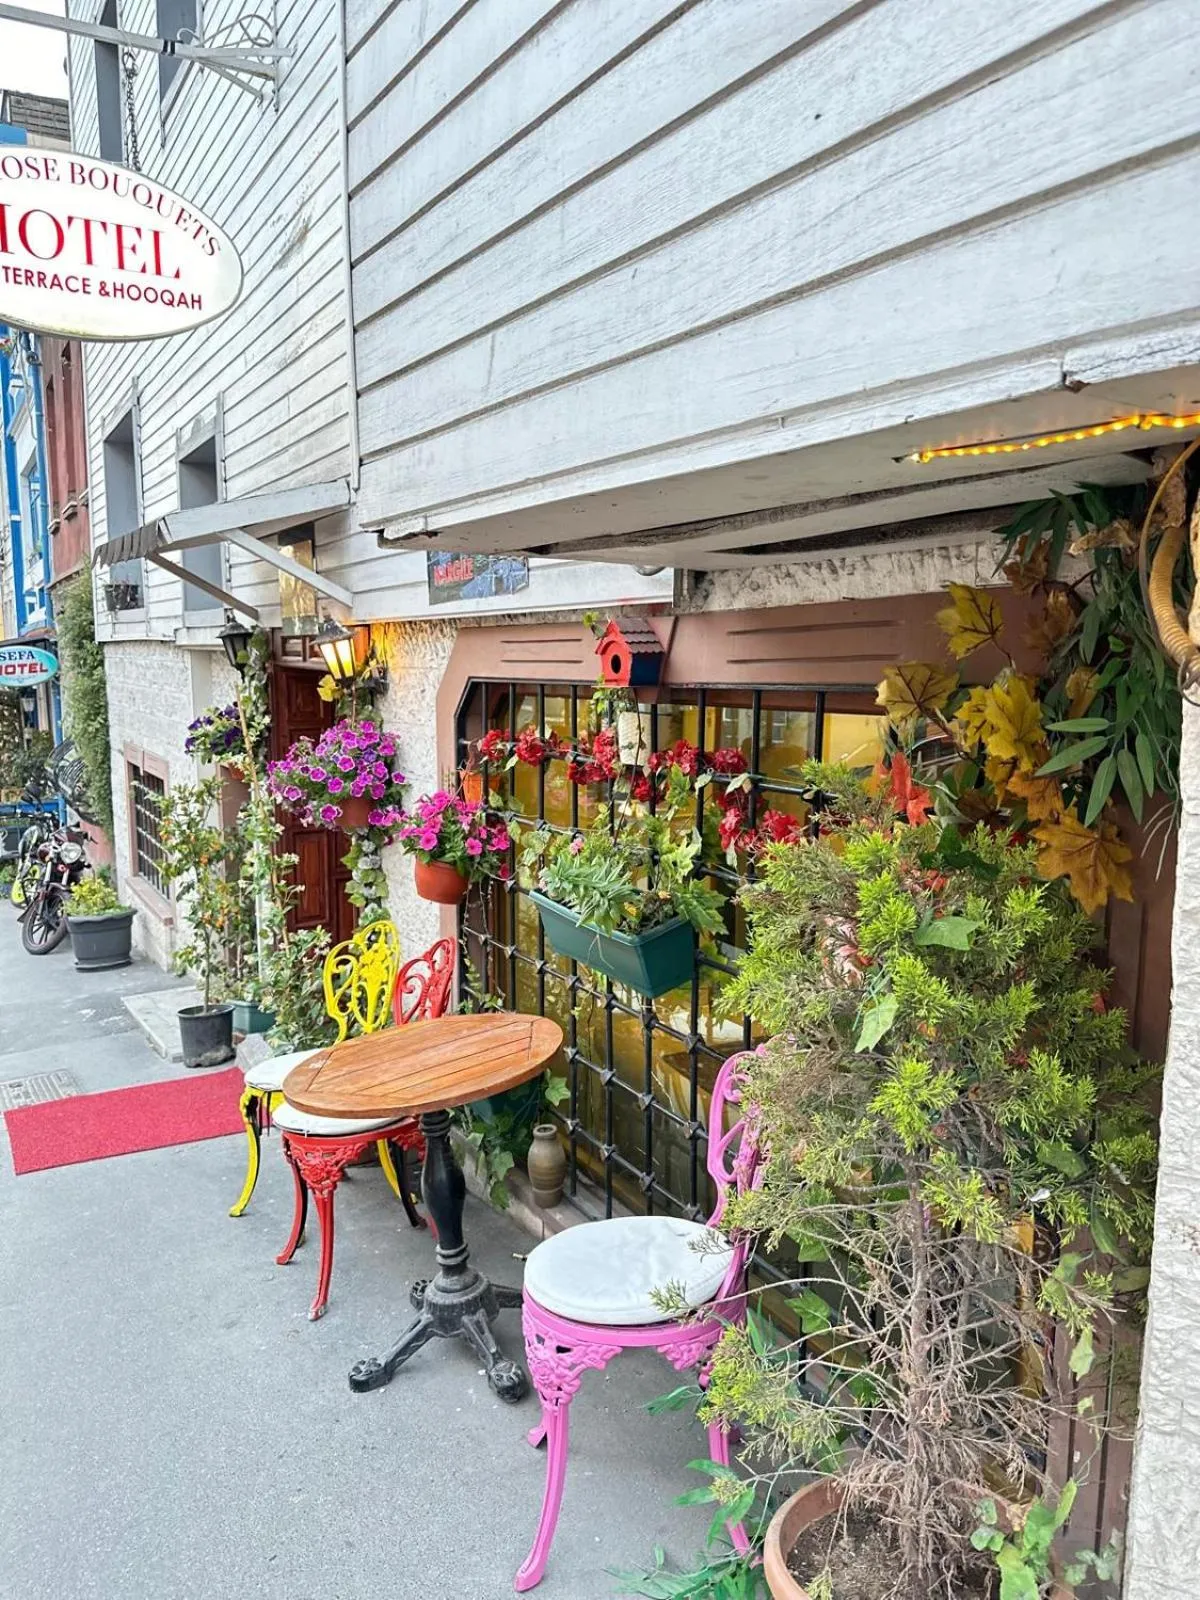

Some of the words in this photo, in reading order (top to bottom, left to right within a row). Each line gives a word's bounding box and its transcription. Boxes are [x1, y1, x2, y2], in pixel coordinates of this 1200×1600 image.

[0, 156, 60, 182] OSE
[69, 161, 222, 256] BOUQUETS
[1, 266, 91, 295] TERRACE
